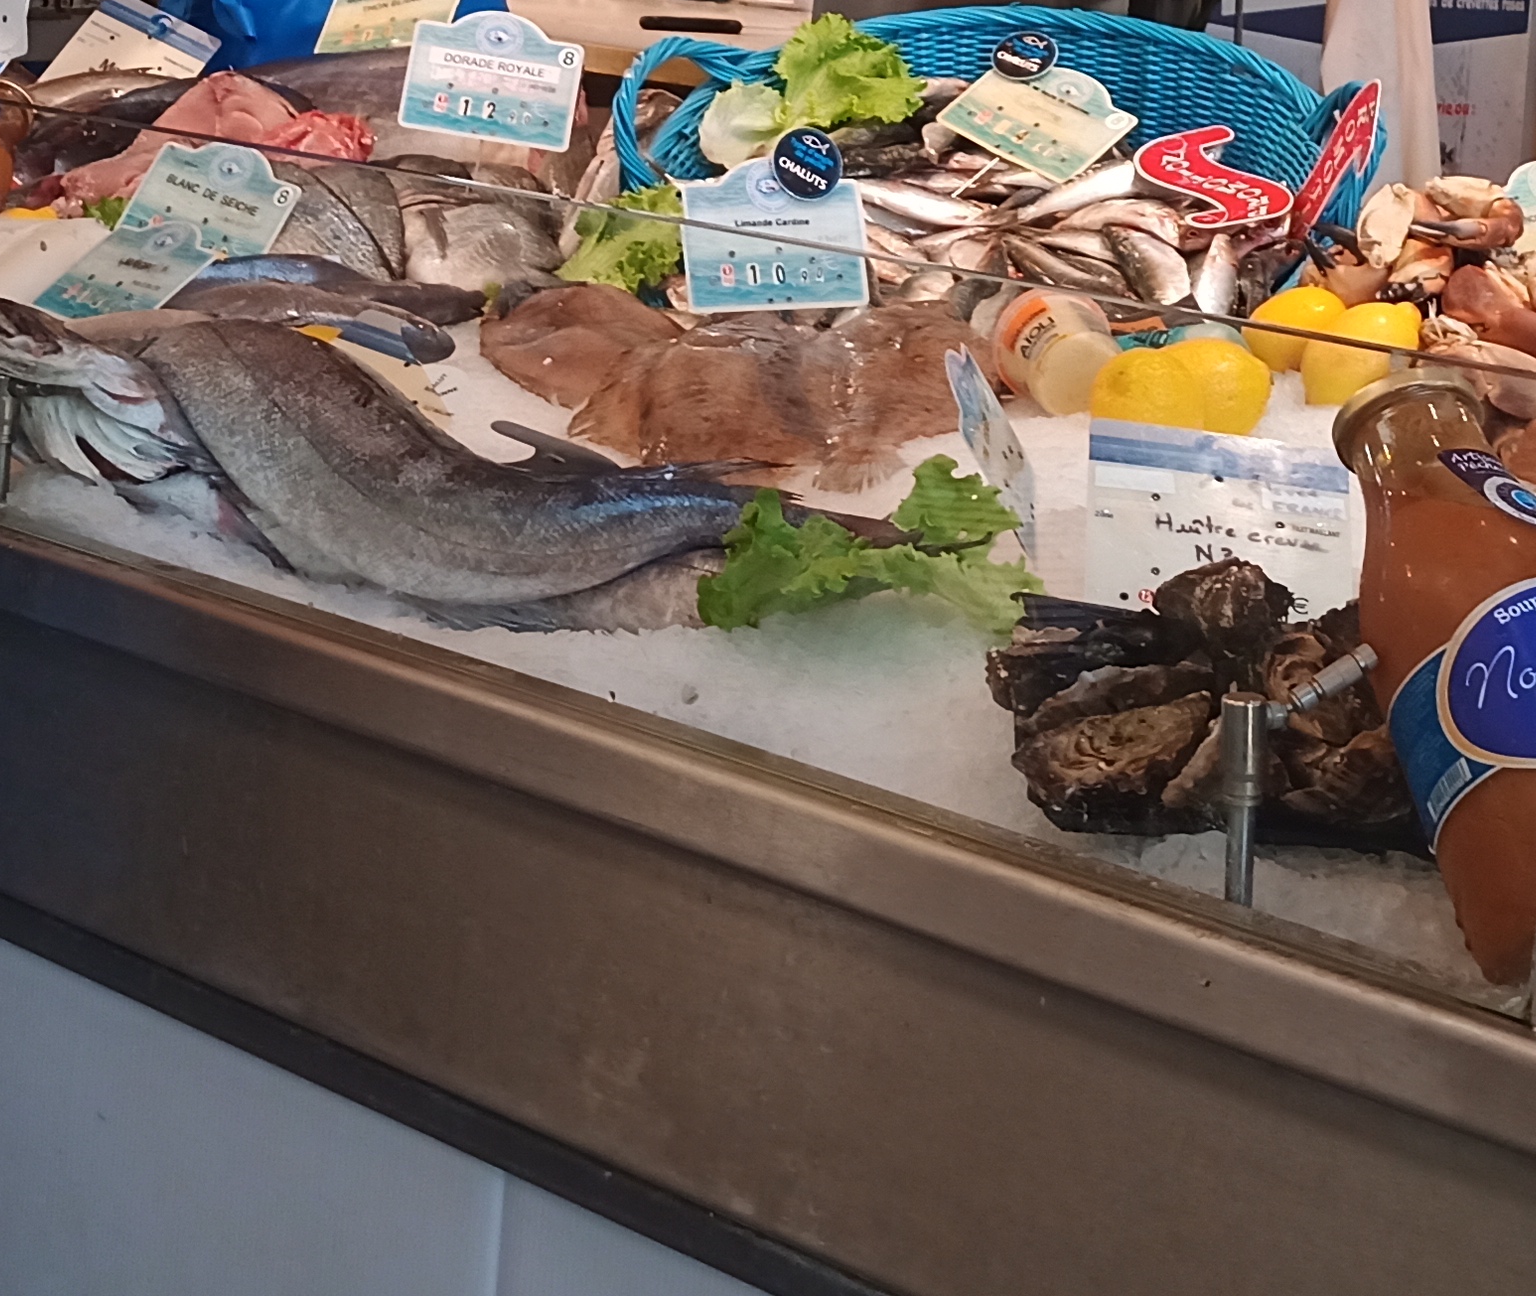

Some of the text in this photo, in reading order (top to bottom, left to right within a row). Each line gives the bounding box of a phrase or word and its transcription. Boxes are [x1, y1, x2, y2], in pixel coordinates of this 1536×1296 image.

[444, 52, 545, 79] DORADE ROYALE
[563, 52, 575, 66] 8
[778, 156, 828, 191] CHALUTS
[166, 173, 260, 217] BLANC DE SEICHE
